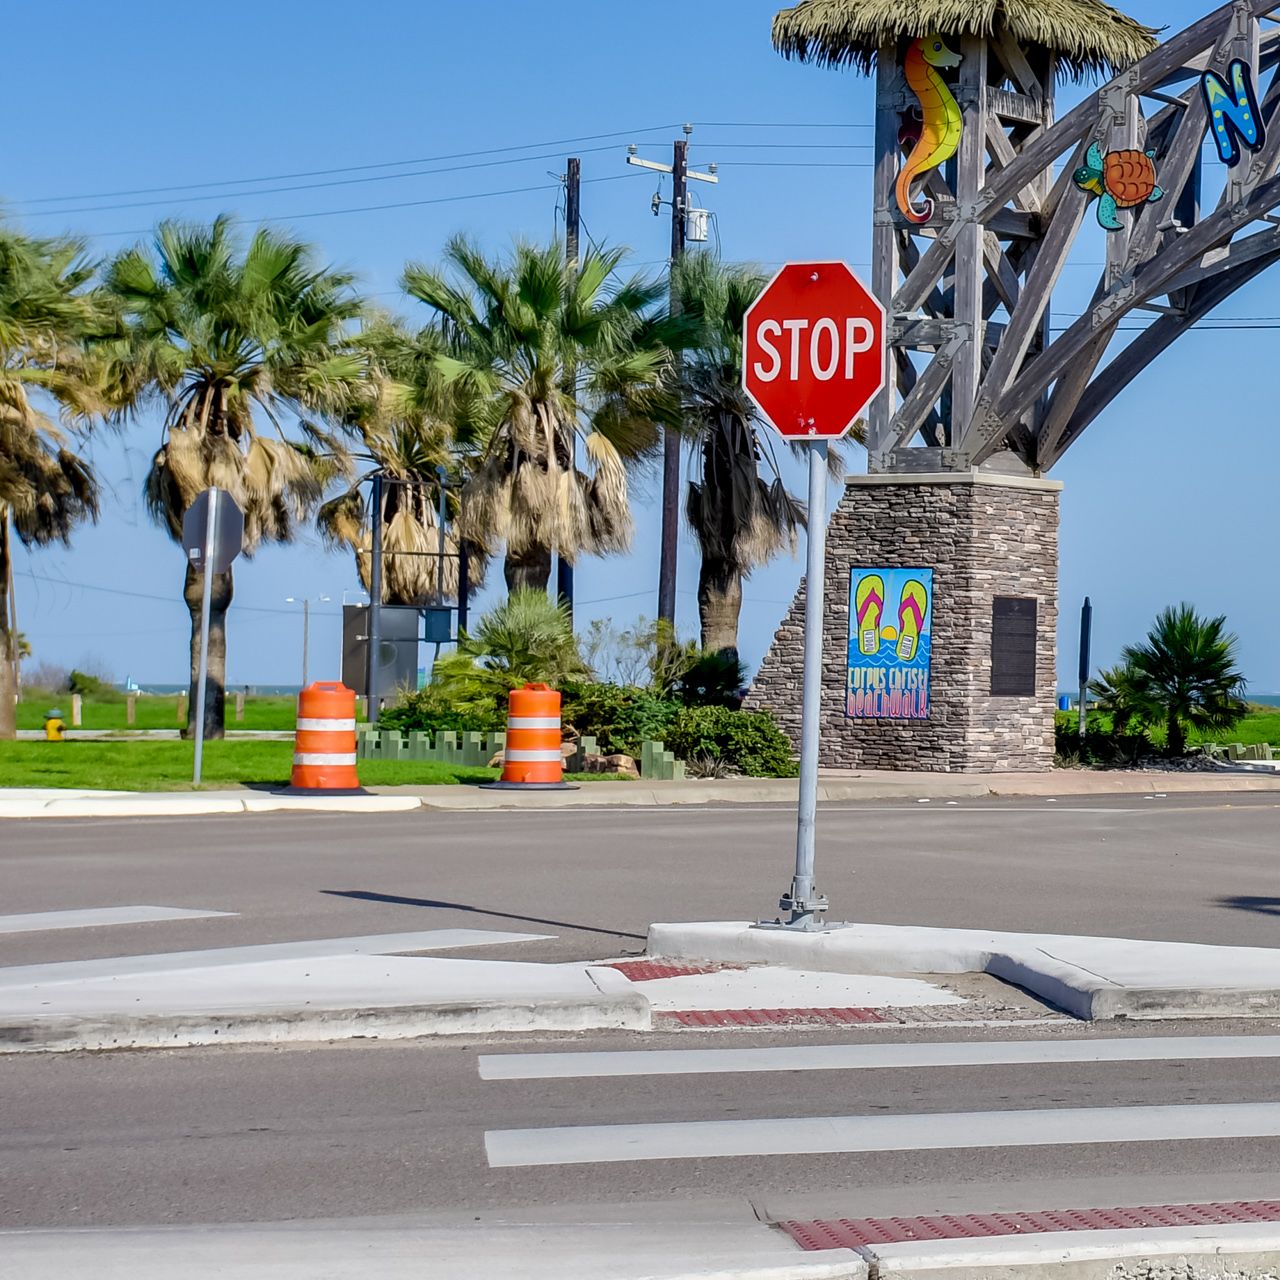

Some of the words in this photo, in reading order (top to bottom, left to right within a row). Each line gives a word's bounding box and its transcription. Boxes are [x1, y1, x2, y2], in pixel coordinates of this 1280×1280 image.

[753, 317, 874, 382] STOP
[848, 668, 887, 689] corpus
[889, 667, 928, 689] christi
[847, 689, 927, 718] beachwalk
